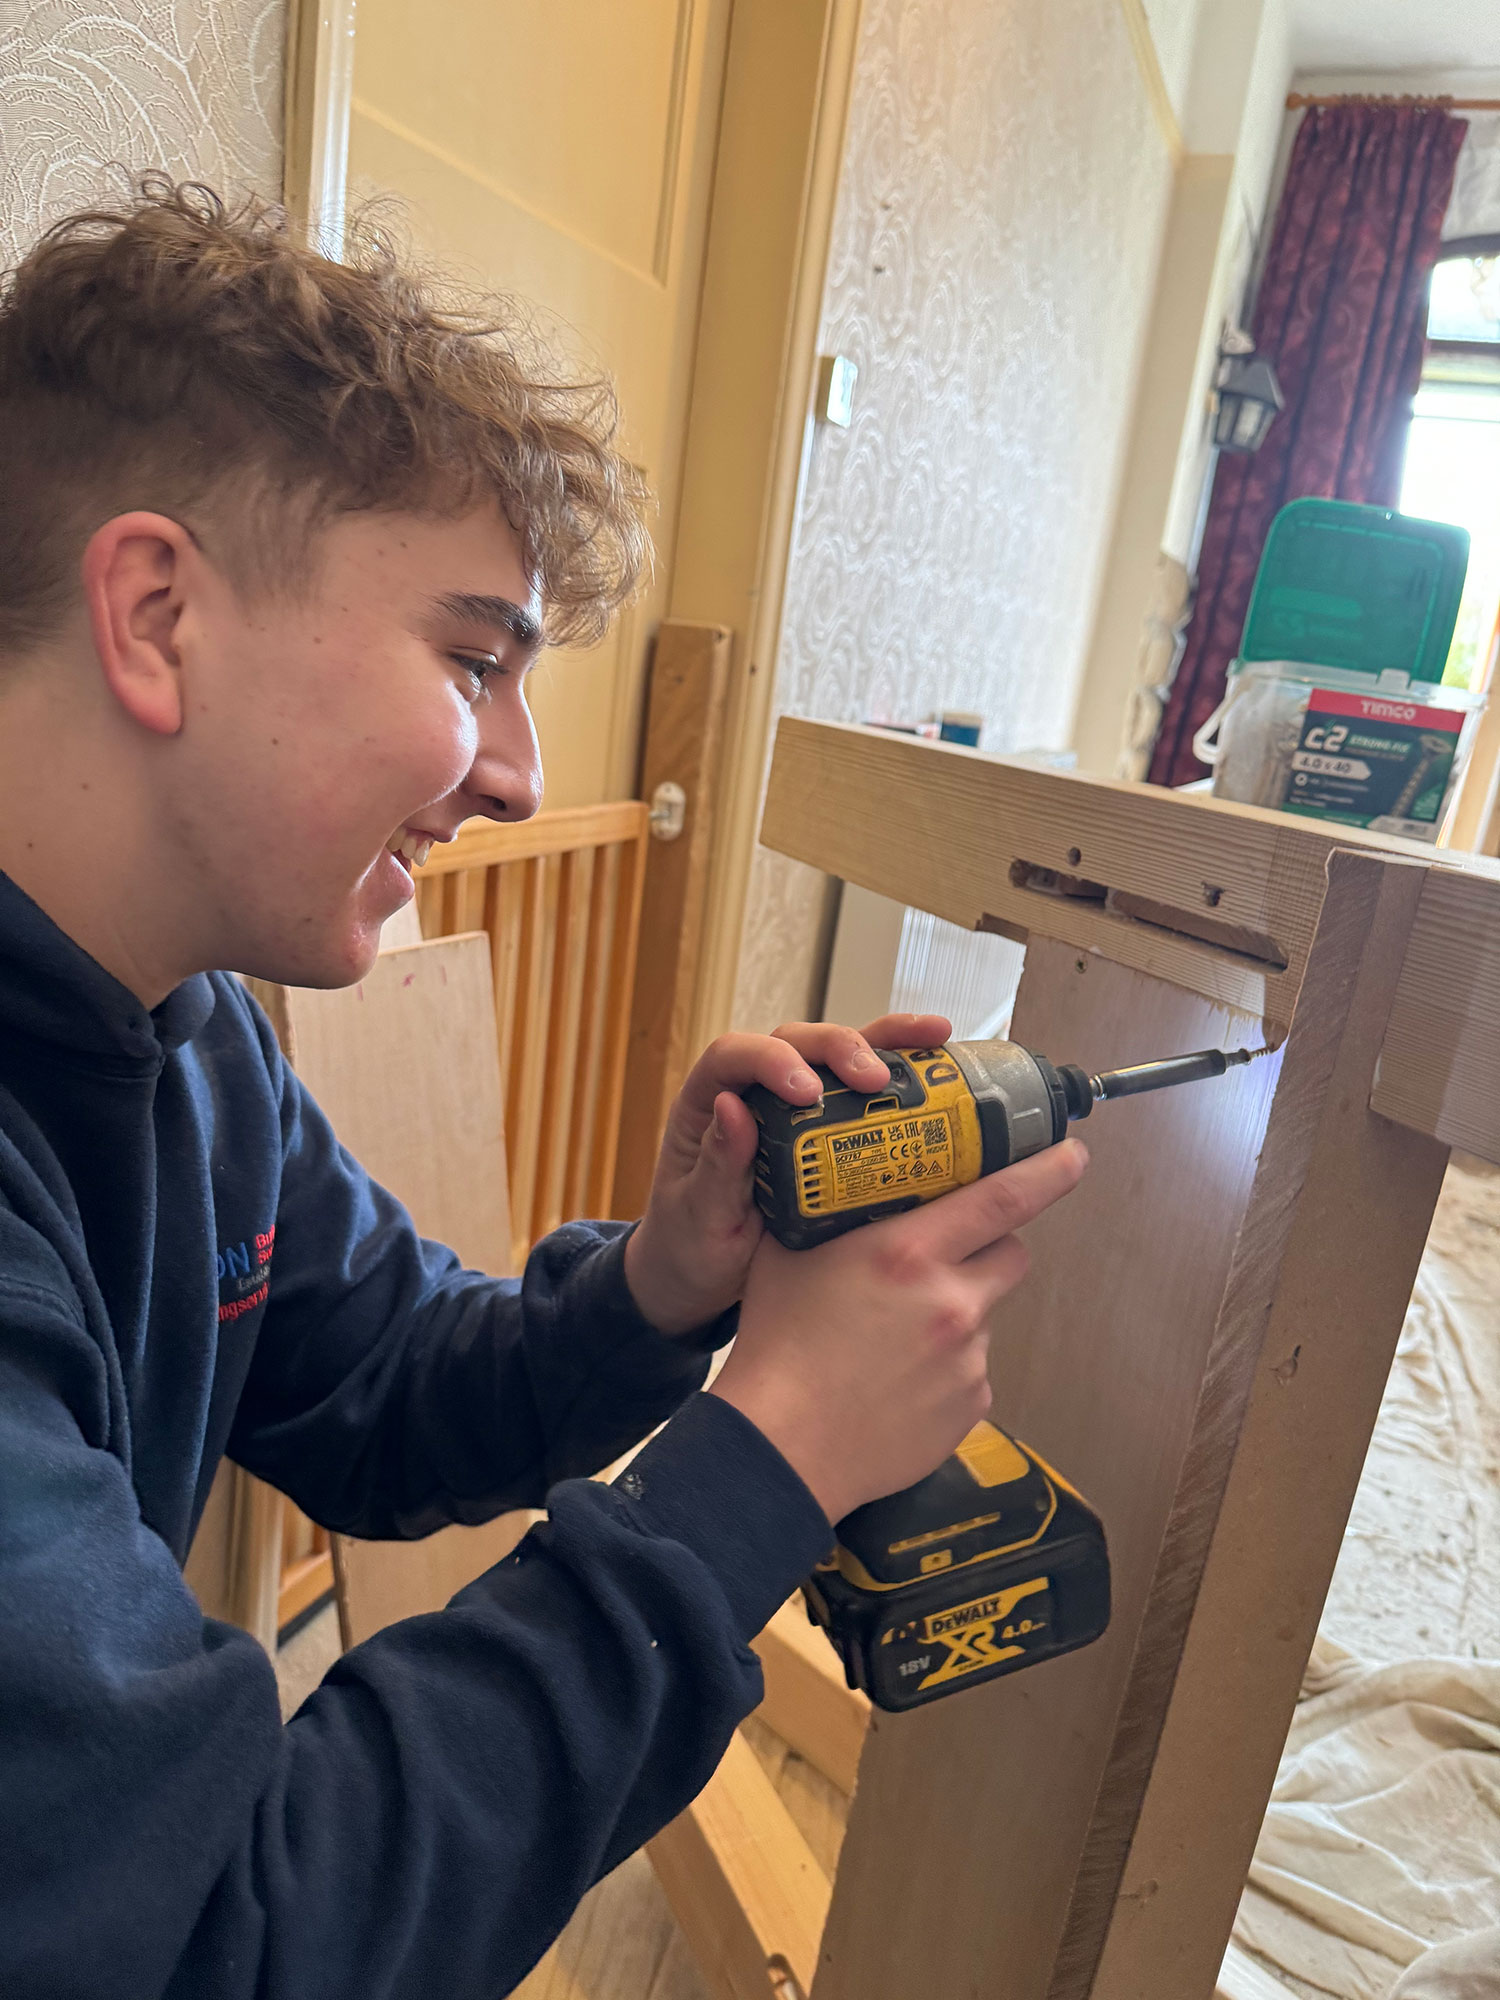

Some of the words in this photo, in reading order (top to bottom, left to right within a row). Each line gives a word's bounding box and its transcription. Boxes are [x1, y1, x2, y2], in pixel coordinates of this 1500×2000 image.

[1361, 699, 1416, 721] TIMCO
[890, 1143, 910, 1160] CE
[928, 1620, 1012, 1682] XR
[899, 1655, 932, 1677] 18V
